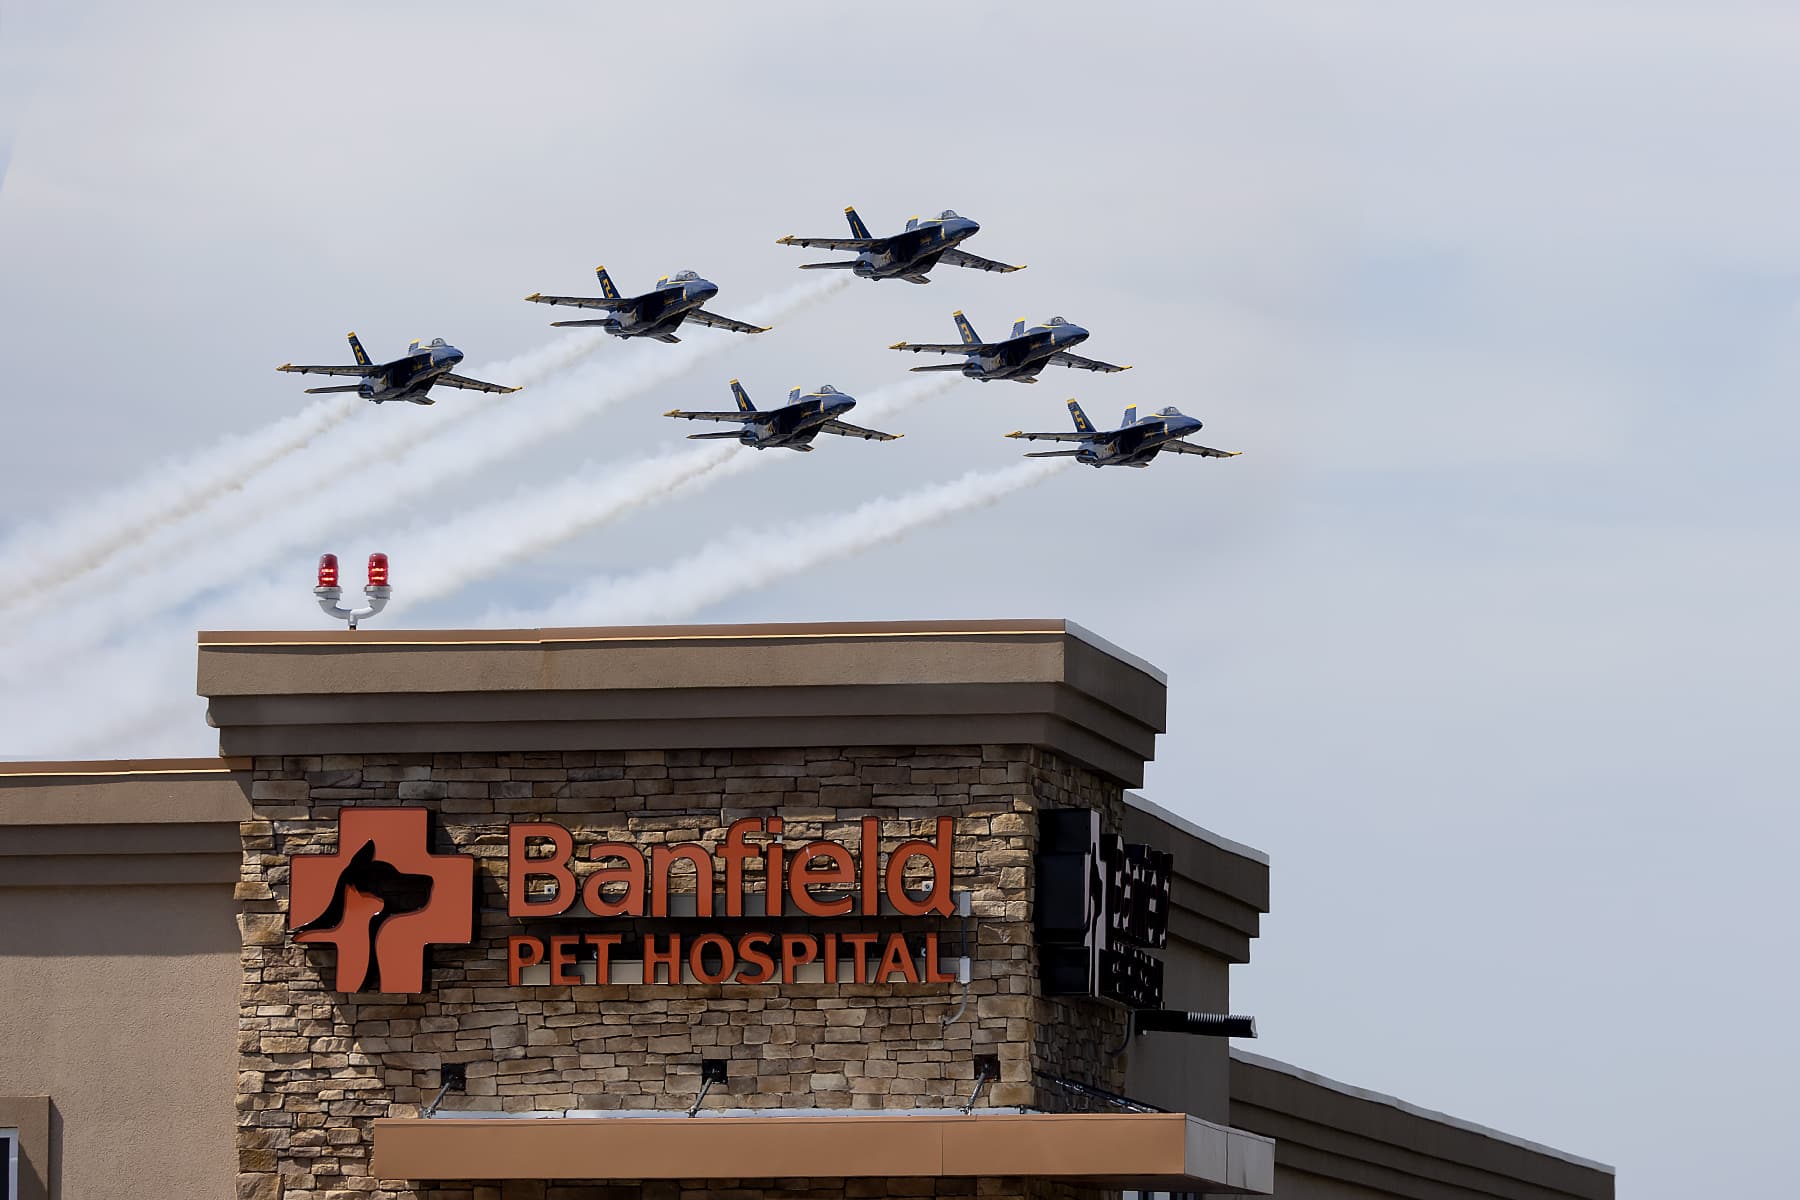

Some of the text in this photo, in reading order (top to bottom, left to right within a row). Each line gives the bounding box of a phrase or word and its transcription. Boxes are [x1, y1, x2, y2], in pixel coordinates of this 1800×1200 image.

[602, 278, 614, 298] 2
[354, 345, 365, 364] 6
[1073, 410, 1086, 429] 5
[509, 818, 956, 918] Banfield
[509, 933, 955, 987] PET HOSPITAL
